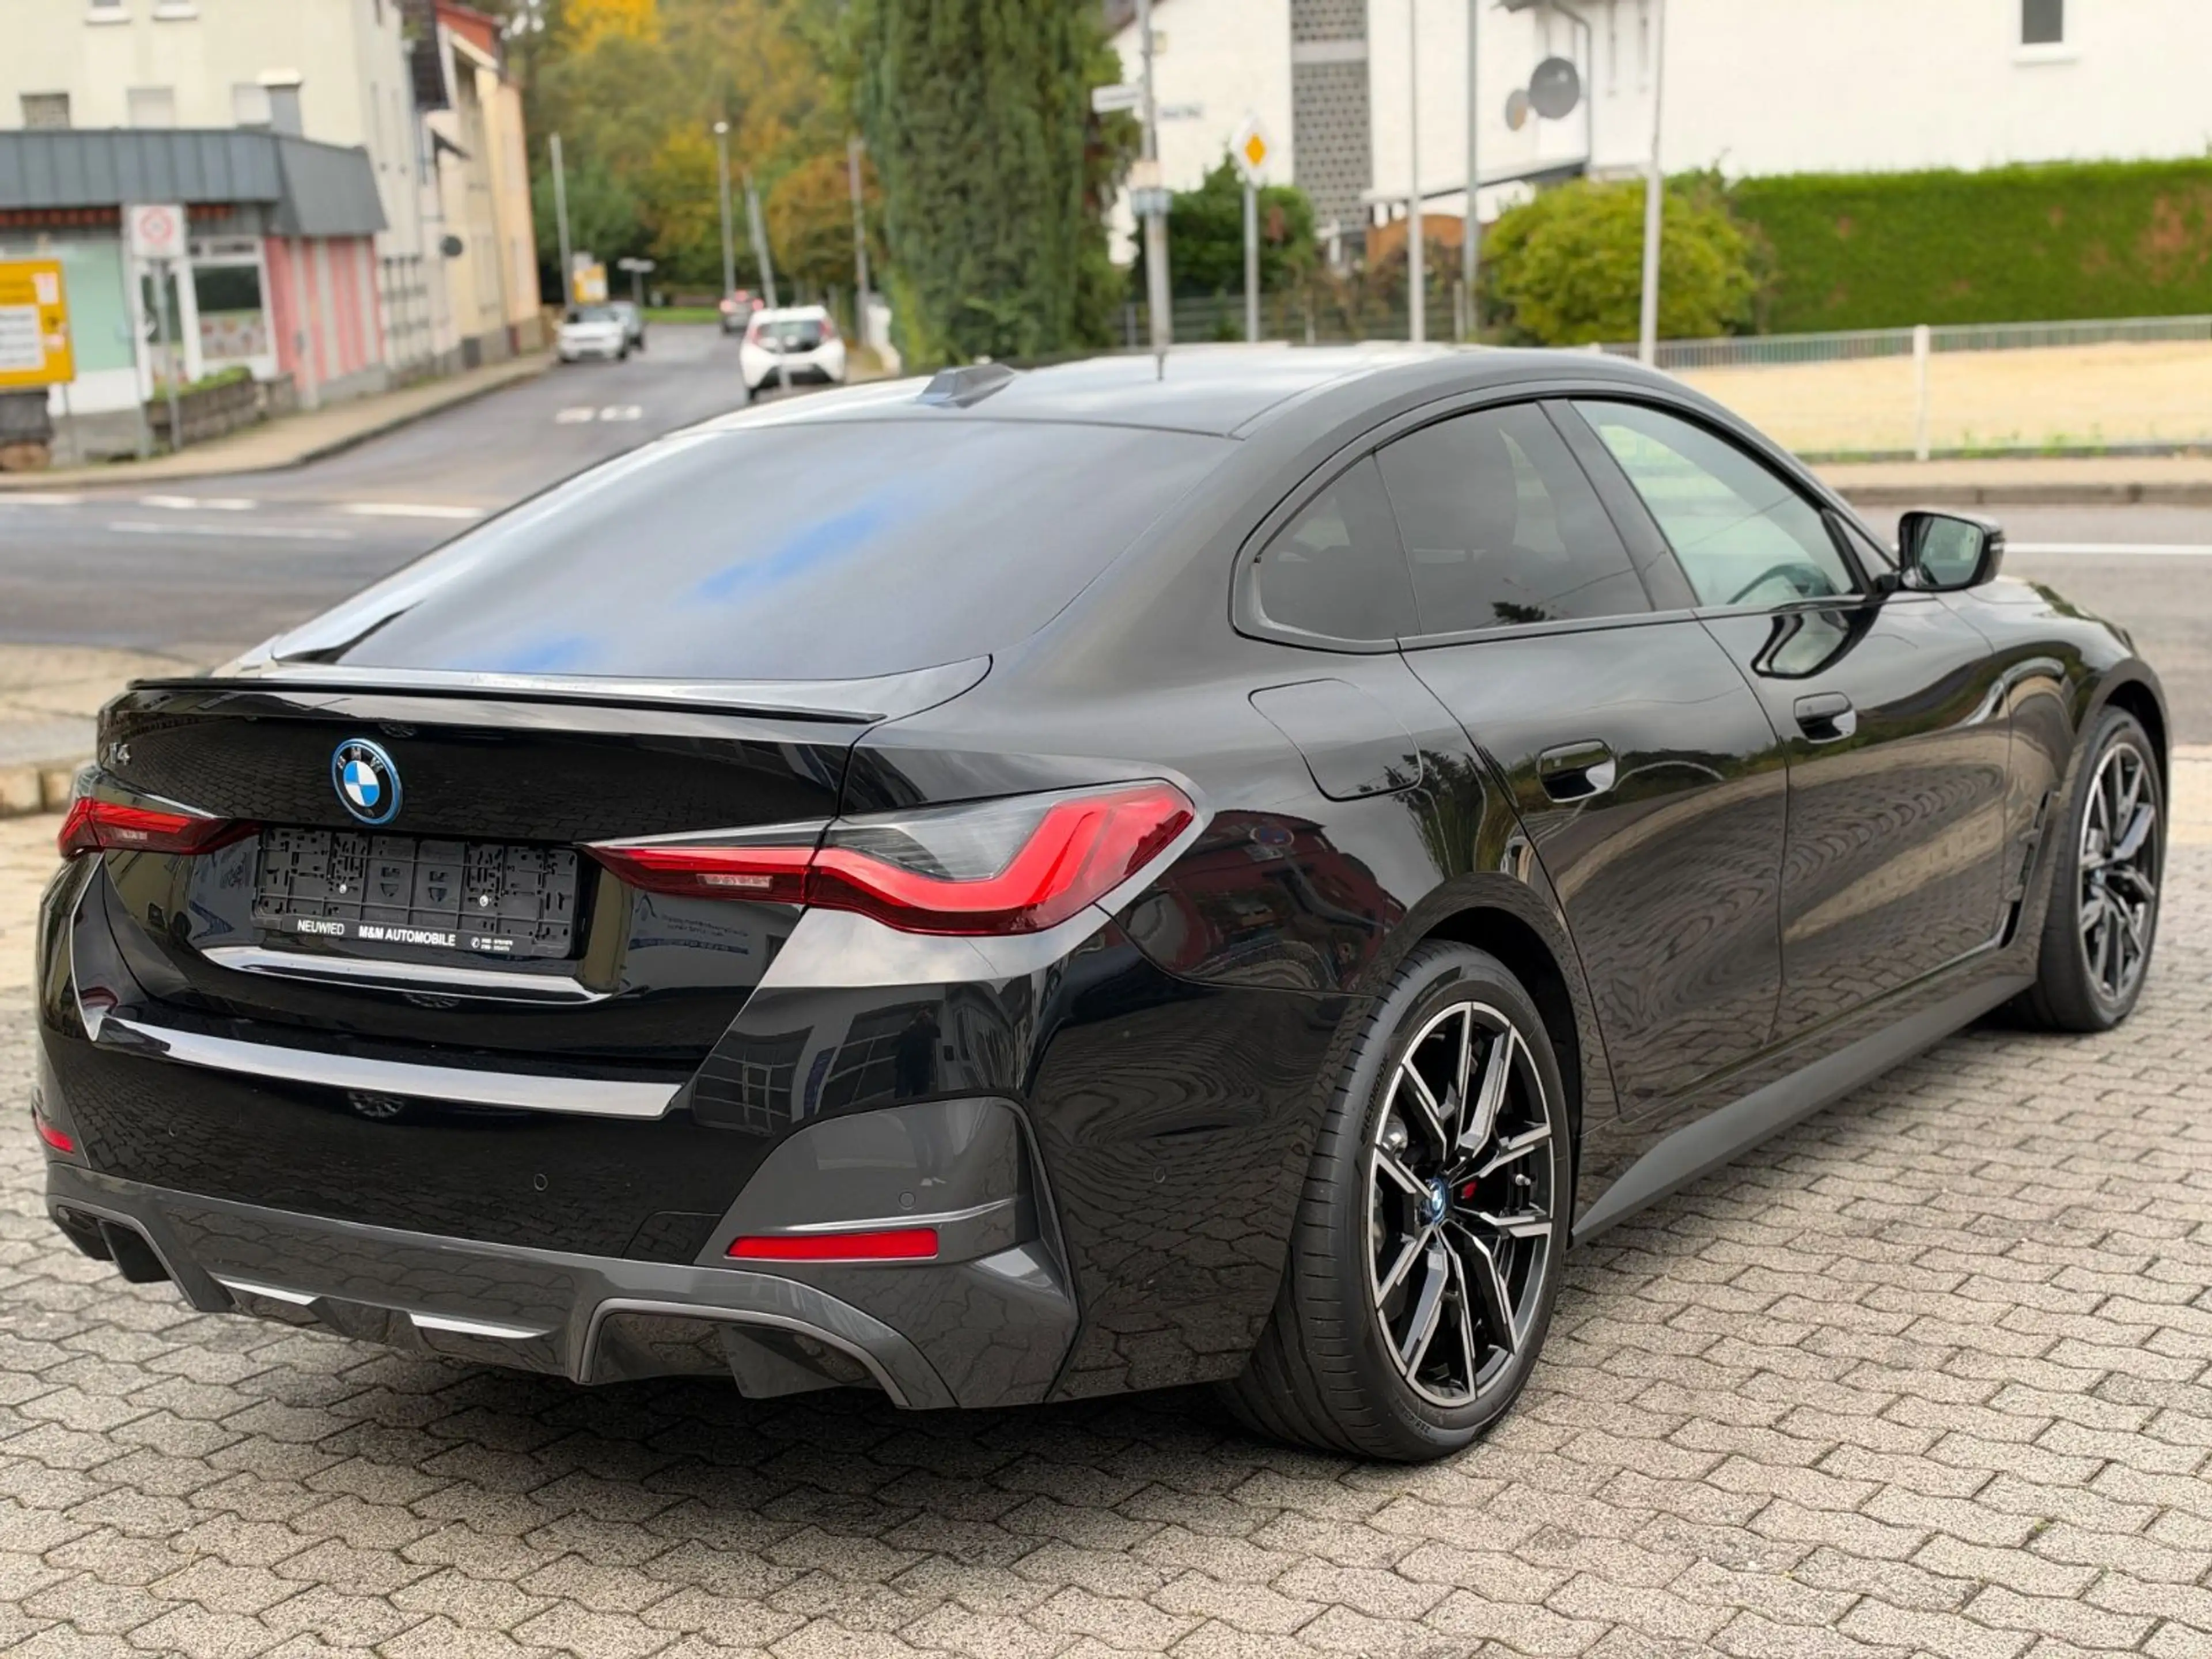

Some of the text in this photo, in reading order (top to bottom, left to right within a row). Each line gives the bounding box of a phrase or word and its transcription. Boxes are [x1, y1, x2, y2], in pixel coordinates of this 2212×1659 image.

[337, 747, 384, 774] BMW
[297, 919, 456, 946] NEUWIED M&M AUTOMOBILE
